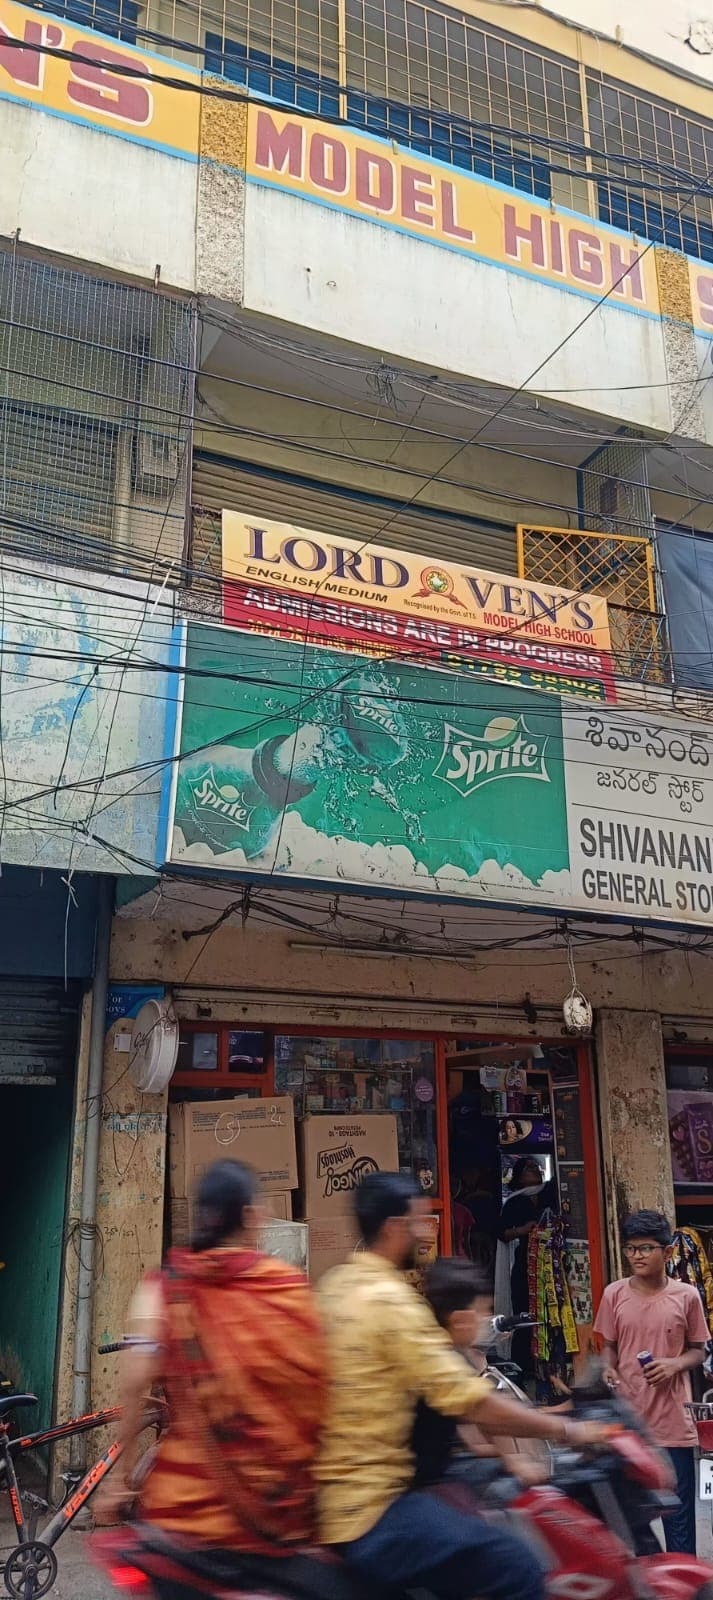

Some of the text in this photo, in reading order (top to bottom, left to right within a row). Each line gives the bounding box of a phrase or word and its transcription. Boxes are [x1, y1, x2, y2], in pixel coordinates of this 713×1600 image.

[255, 110, 475, 244] MODEL
[503, 203, 647, 304] HIGH
[244, 524, 594, 631] LORD VEN'S
[246, 566, 388, 603] ENGLISH MEDIUM
[243, 588, 398, 636] ADMISSIONS
[403, 619, 452, 646] ARE
[483, 612, 598, 646] MODEL HIGH SCHOOL
[352, 695, 400, 733] Sprite
[445, 730, 539, 786] Sprite
[194, 778, 248, 820] Sprite
[597, 769, 660, 795] జనరల్
[580, 817, 713, 874] SHIVANAN
[582, 867, 673, 909] GENERAL
[675, 880, 713, 914] STO
